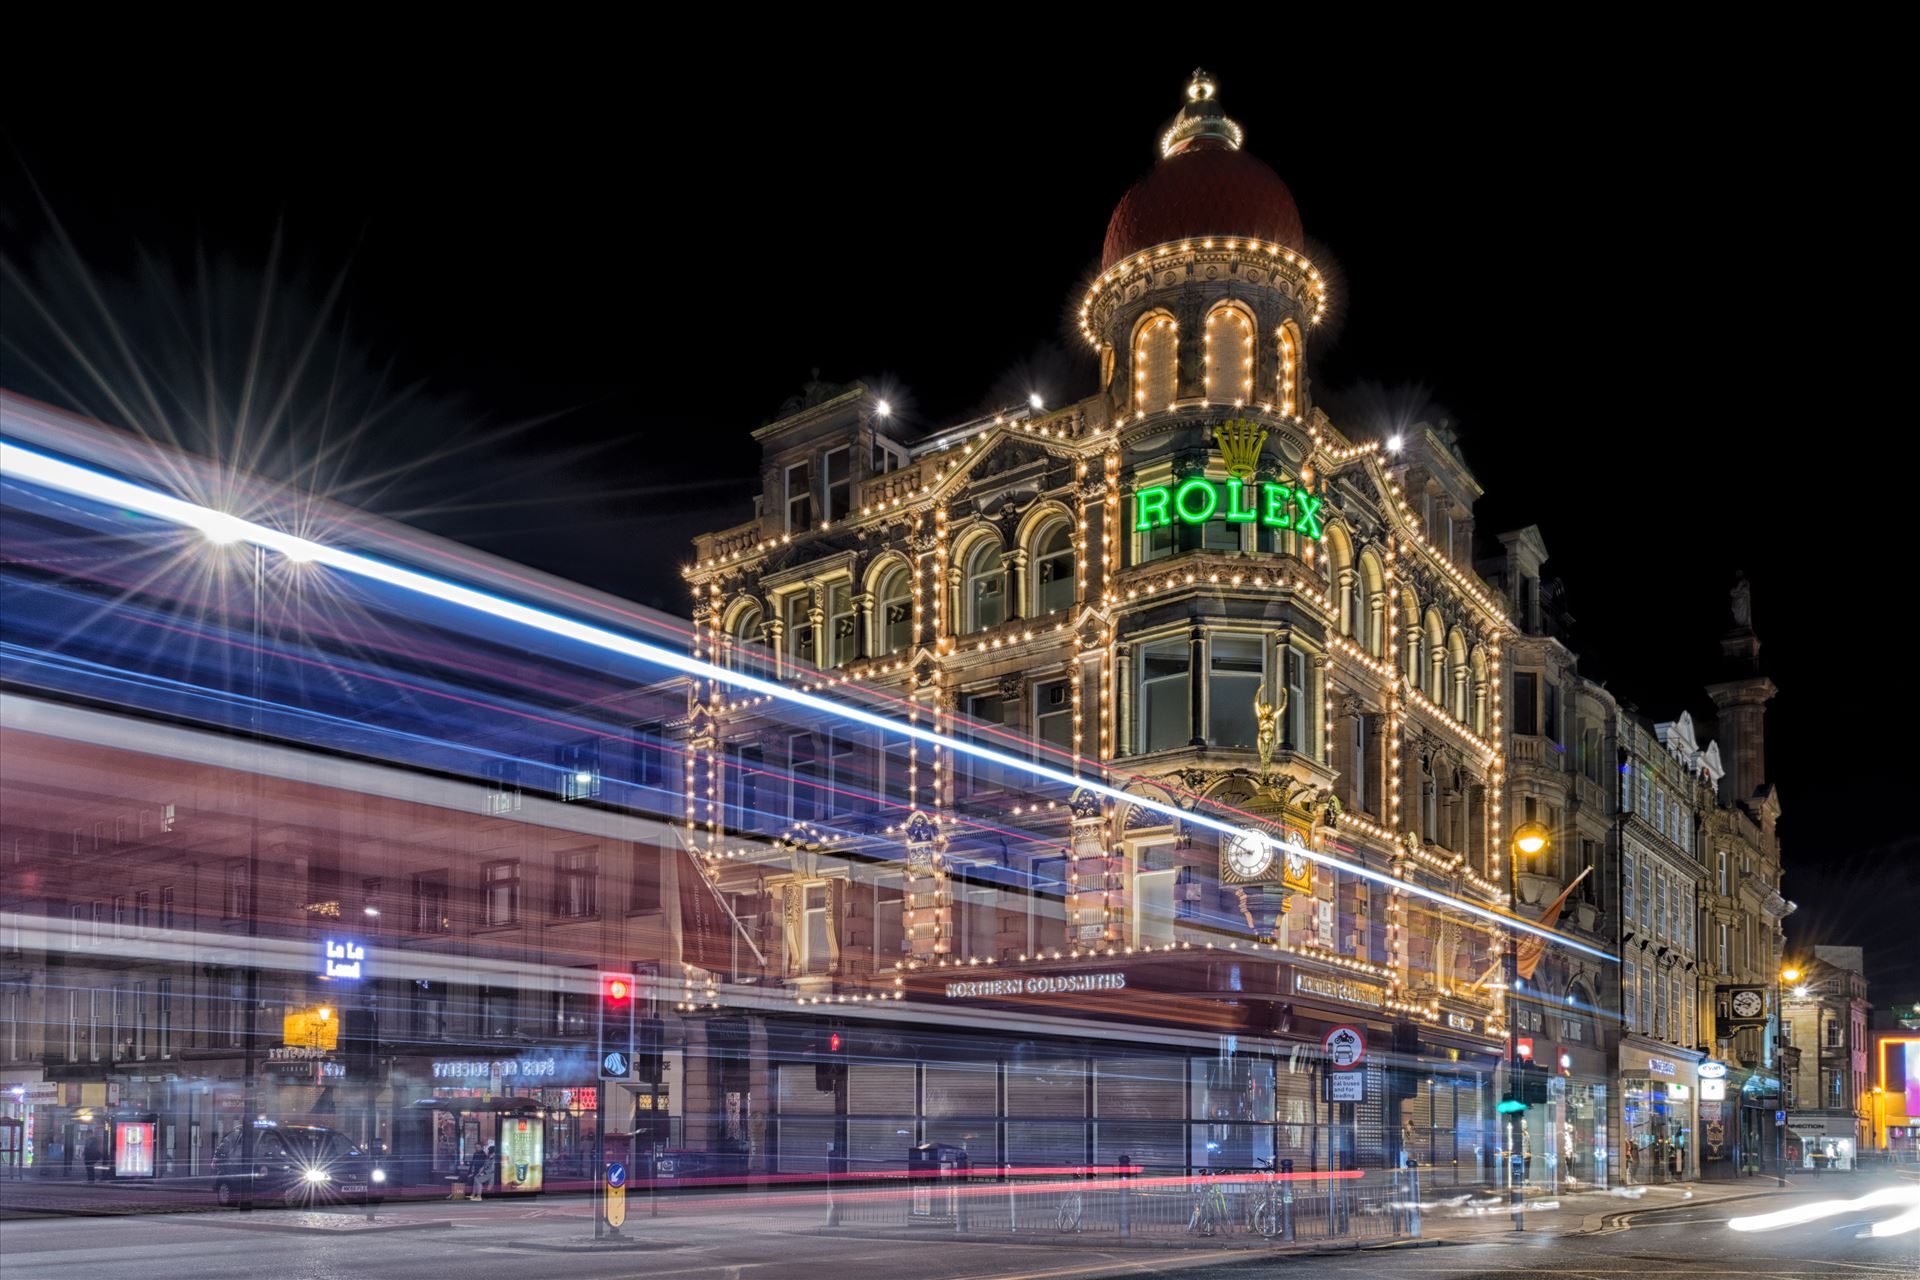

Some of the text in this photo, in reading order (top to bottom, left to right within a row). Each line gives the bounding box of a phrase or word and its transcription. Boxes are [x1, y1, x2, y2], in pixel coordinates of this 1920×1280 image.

[1135, 478, 1321, 540] ROLEX
[326, 941, 364, 960] La La
[326, 959, 361, 979] Land
[945, 972, 1126, 998] NORTHERN GOLDSMITHS
